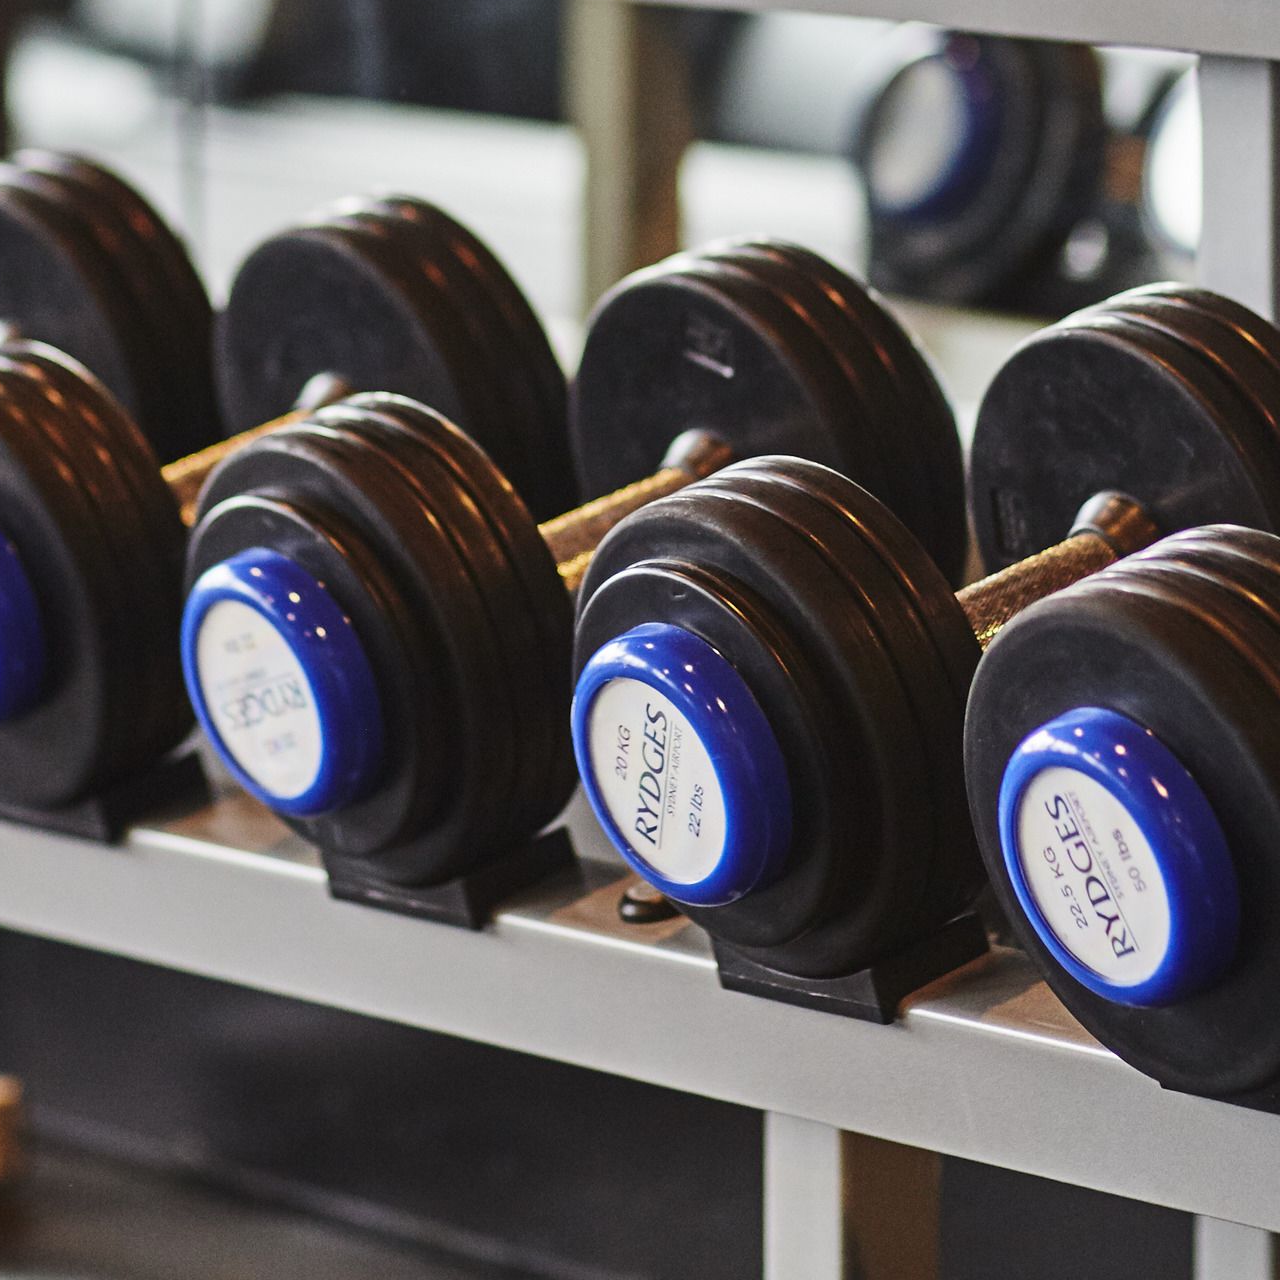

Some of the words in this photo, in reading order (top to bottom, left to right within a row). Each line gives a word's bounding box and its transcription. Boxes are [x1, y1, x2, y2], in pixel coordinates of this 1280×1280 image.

[618, 723, 631, 754] KG
[614, 757, 628, 781] 20
[635, 703, 668, 845] RYDGES
[693, 783, 705, 812] lbs
[688, 811, 703, 838] 22
[1111, 827, 1133, 863] lbs
[1042, 846, 1064, 879] KG
[1044, 793, 1137, 958] RYDGES
[1127, 865, 1147, 893] 50
[1061, 884, 1089, 929] 22.5
